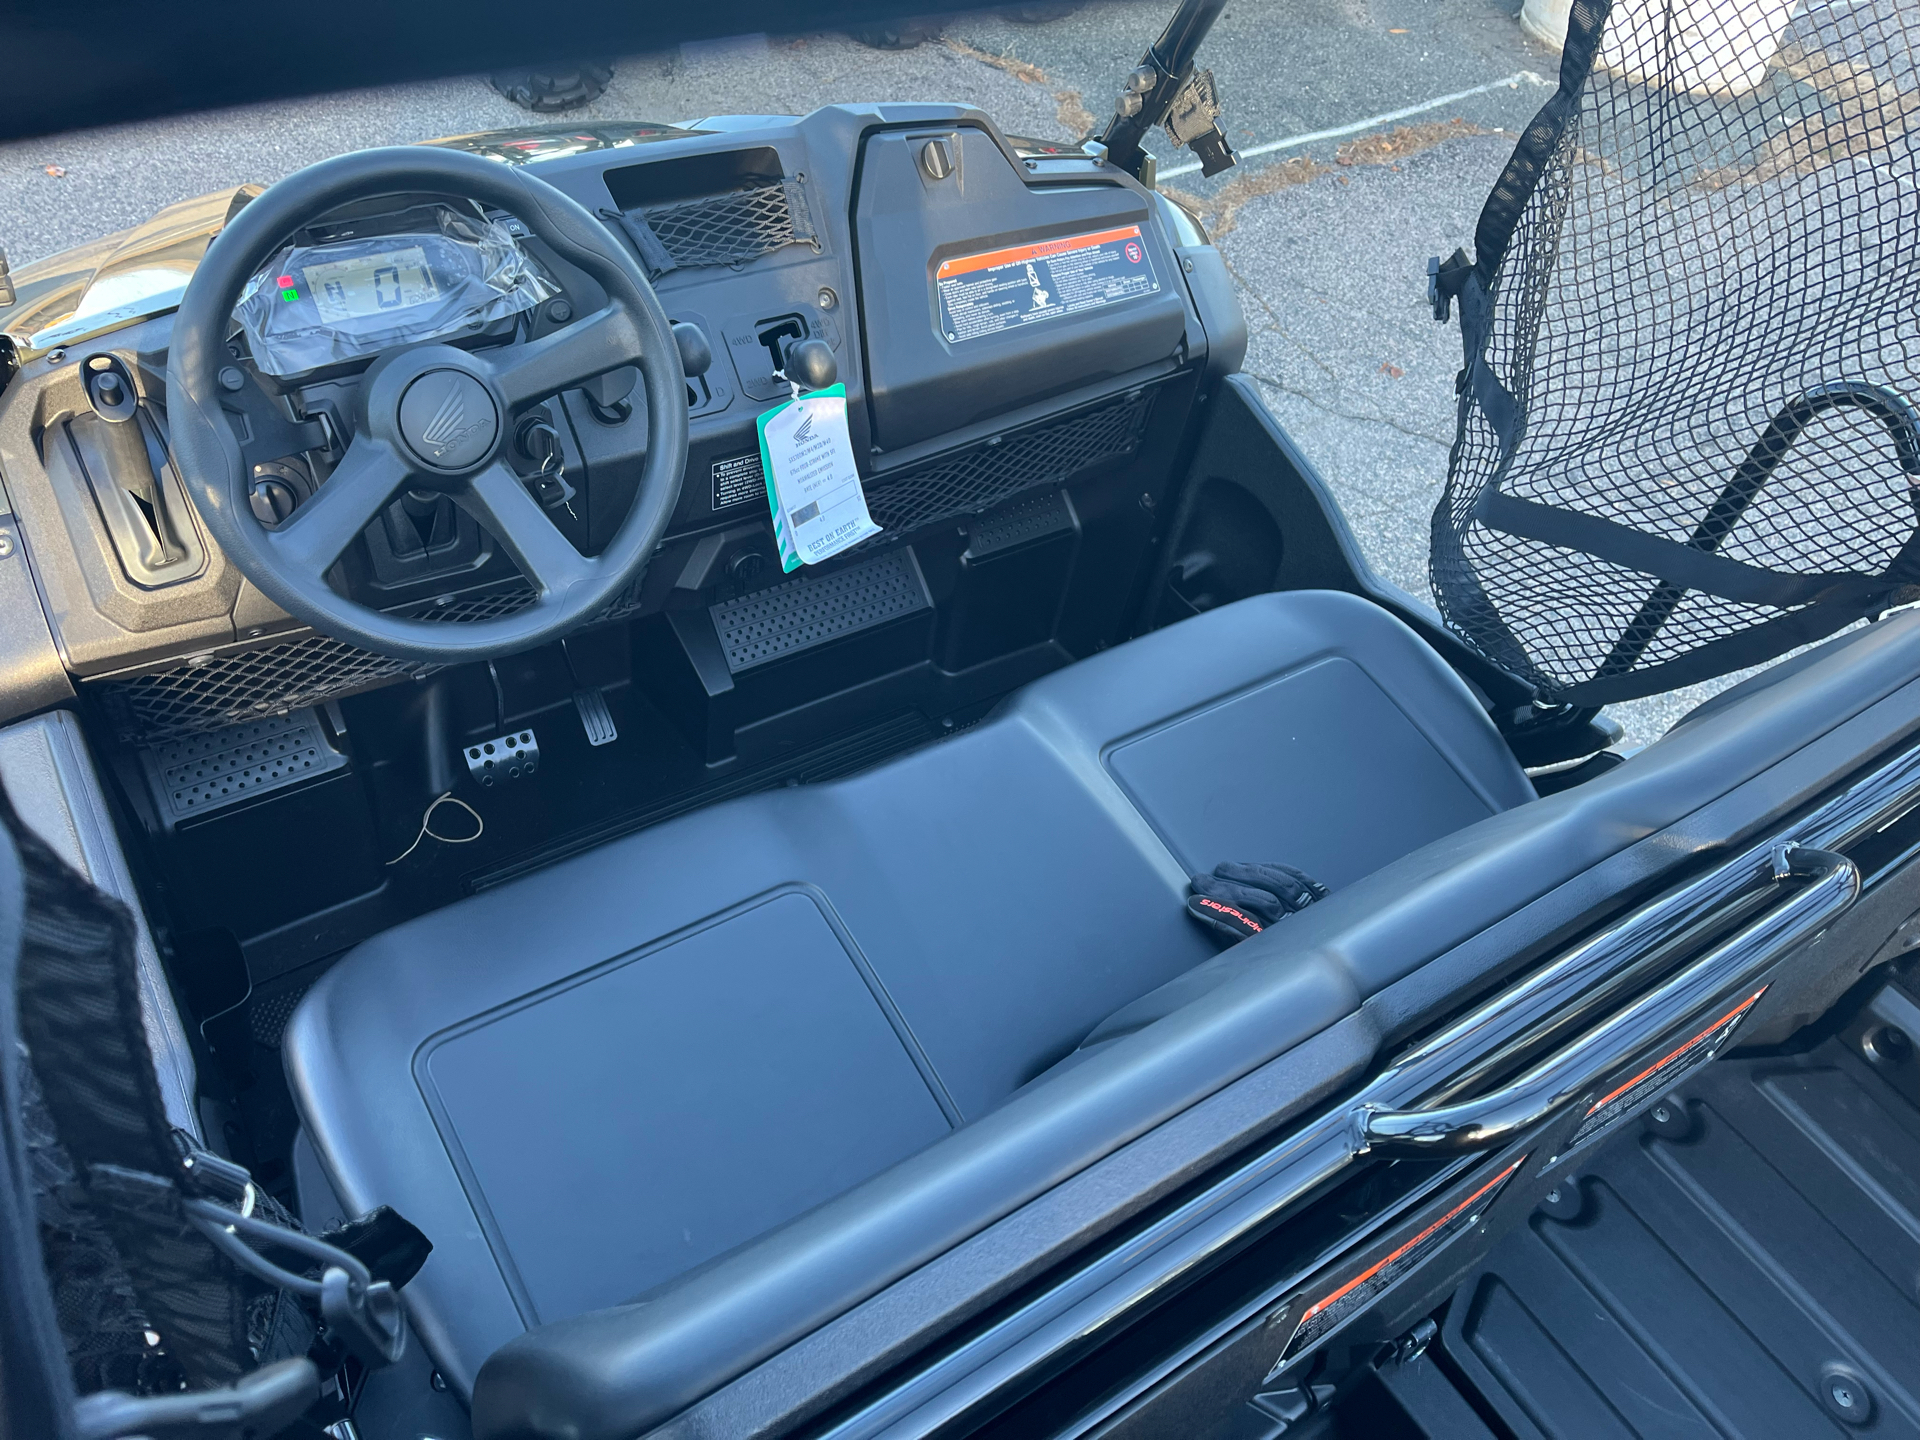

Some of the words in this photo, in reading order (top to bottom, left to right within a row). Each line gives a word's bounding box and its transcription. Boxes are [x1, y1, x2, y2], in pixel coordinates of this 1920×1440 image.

[1038, 241, 1071, 254] WARNING
[811, 318, 830, 329] 4WD
[732, 335, 753, 347] 4WD
[746, 376, 768, 389] 2WD
[715, 387, 724, 398] D
[433, 418, 491, 458] HONDA
[795, 433, 819, 448] HONDA
[807, 536, 825, 552] BEST
[825, 530, 836, 542] ON
[813, 535, 844, 557] PERFORMANCE
